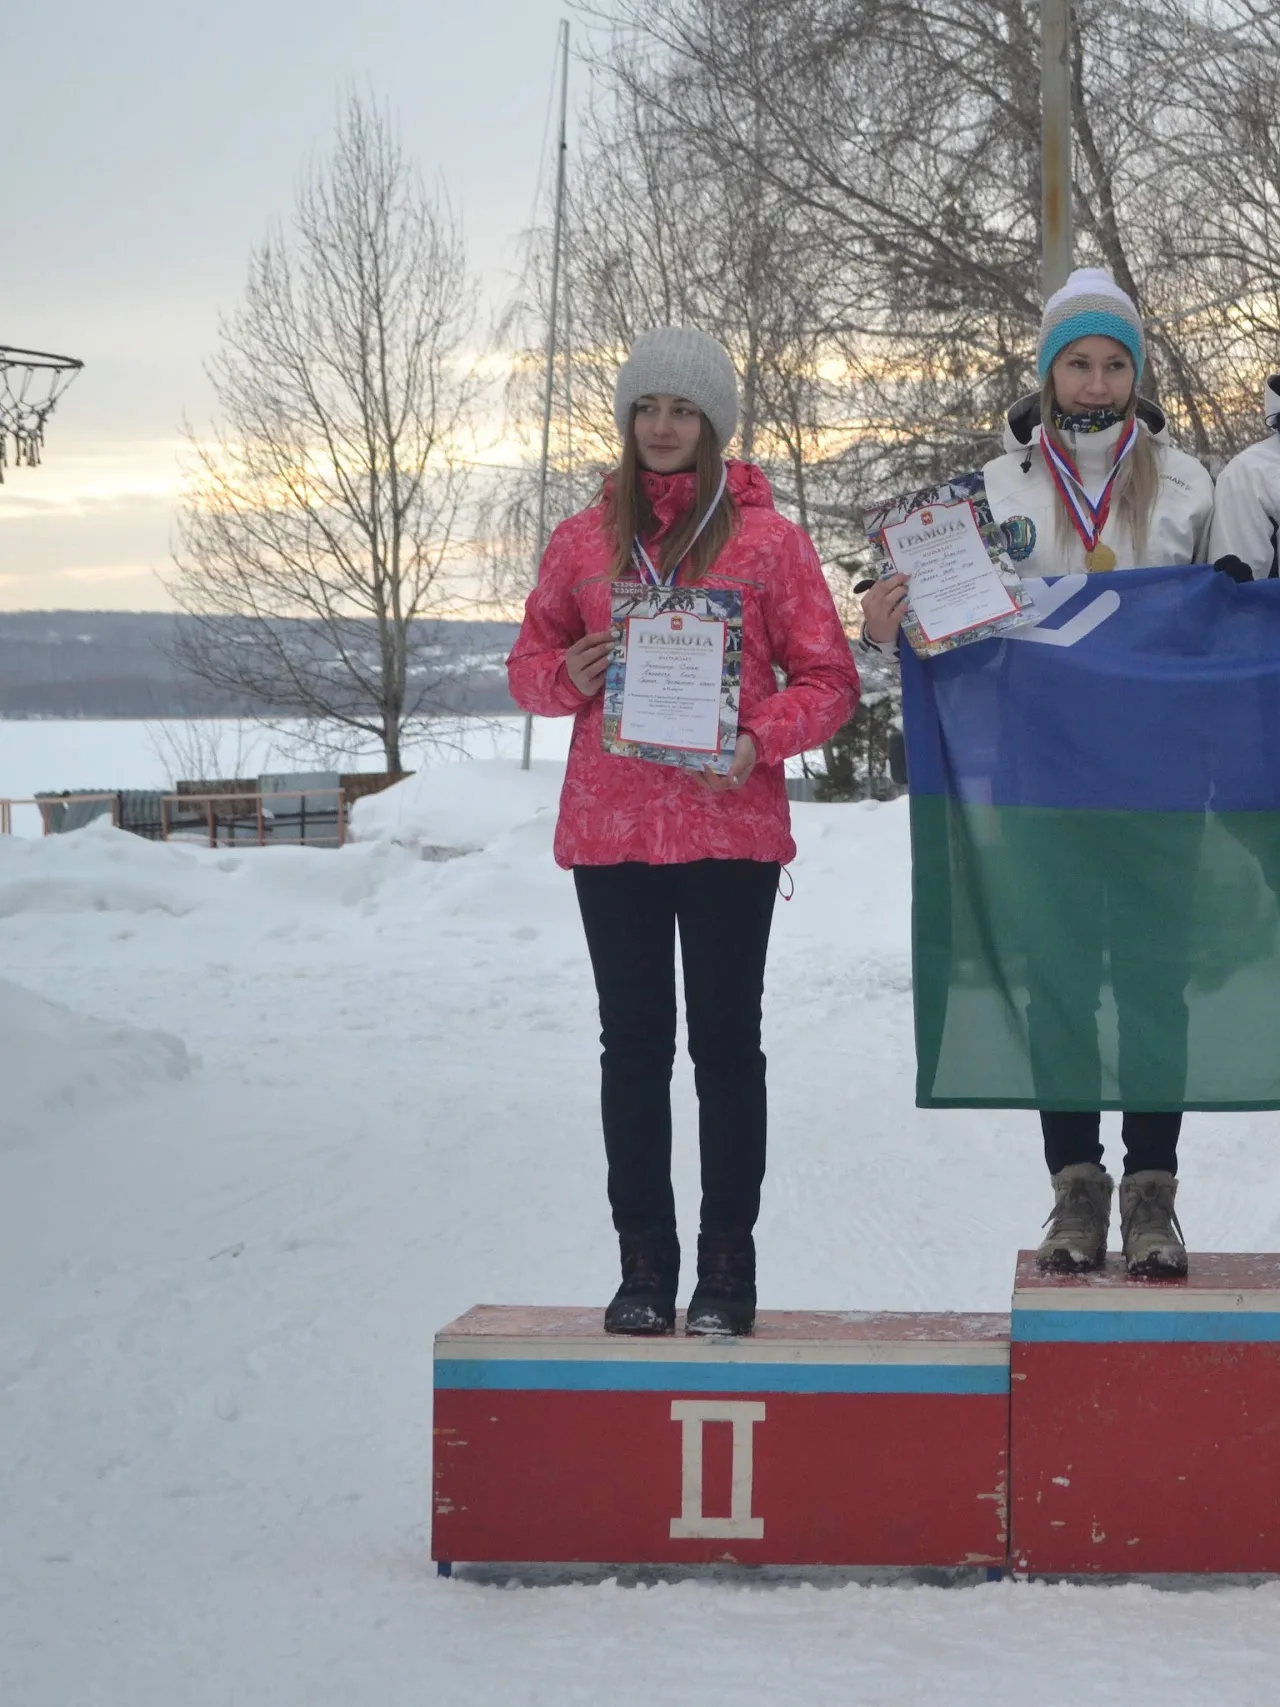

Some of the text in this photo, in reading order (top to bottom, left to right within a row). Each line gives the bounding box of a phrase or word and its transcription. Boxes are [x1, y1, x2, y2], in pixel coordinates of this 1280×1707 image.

[898, 520, 966, 549] ГРАМОТА
[638, 632, 714, 647] ГРАМОТА
[670, 1400, 766, 1540] II
